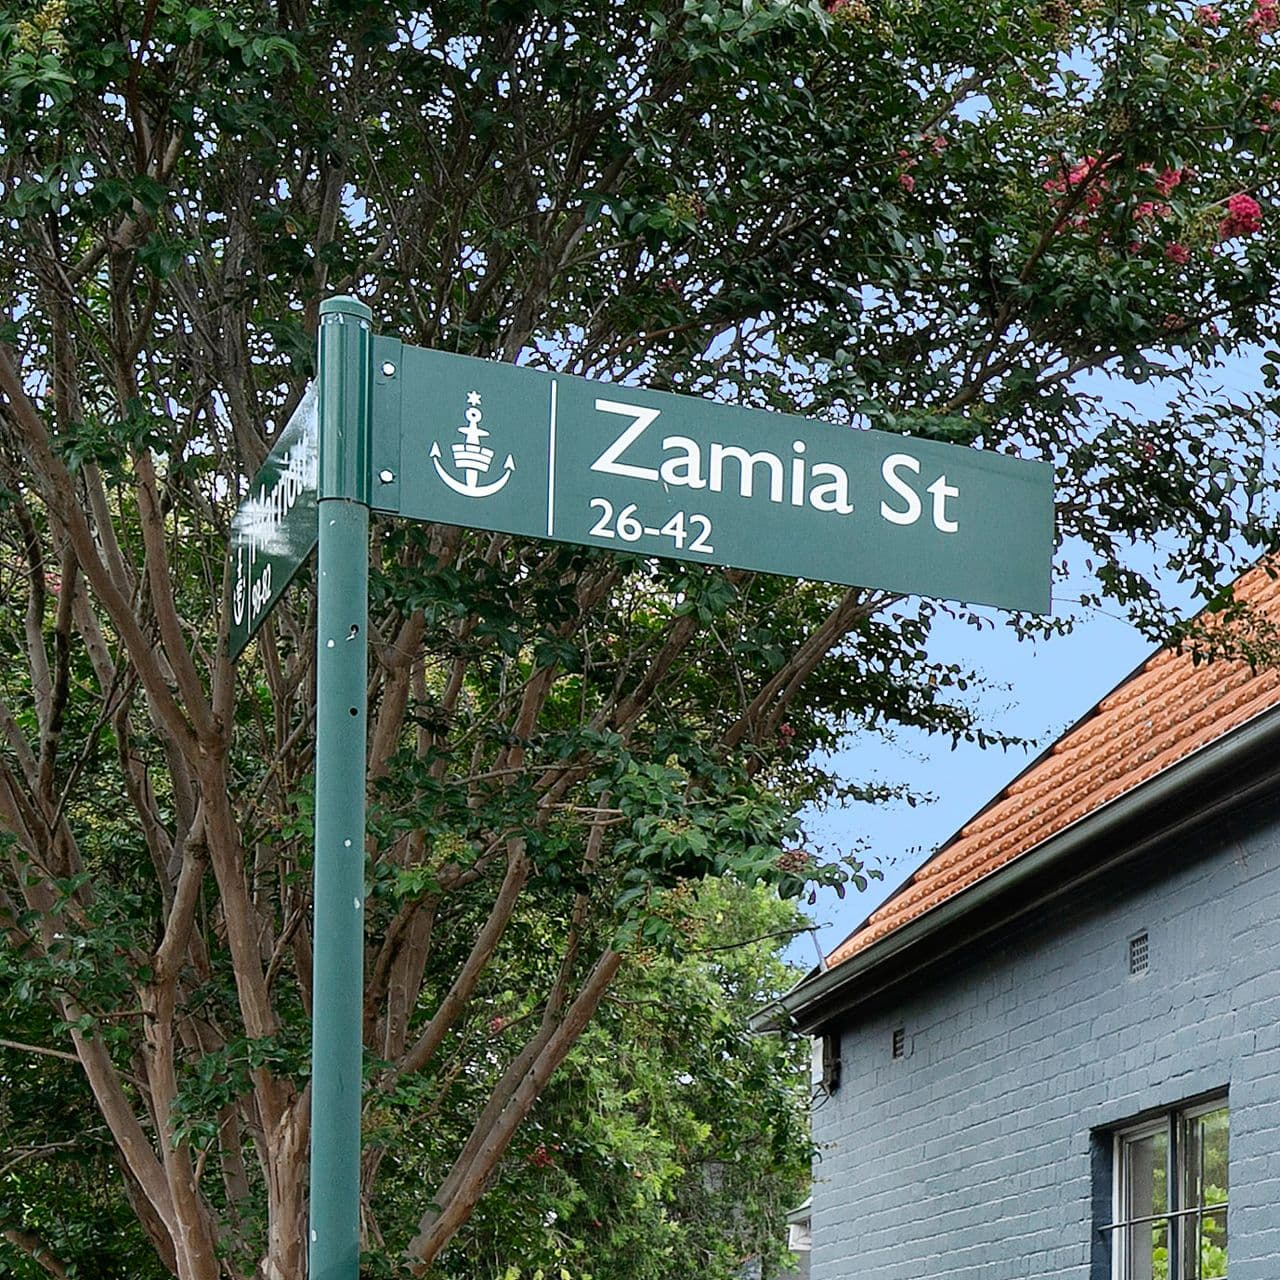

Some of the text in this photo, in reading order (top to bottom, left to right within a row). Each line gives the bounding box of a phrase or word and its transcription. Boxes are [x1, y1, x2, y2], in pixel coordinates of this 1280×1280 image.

[589, 398, 961, 534] Zamia St
[589, 497, 715, 554] 26-42
